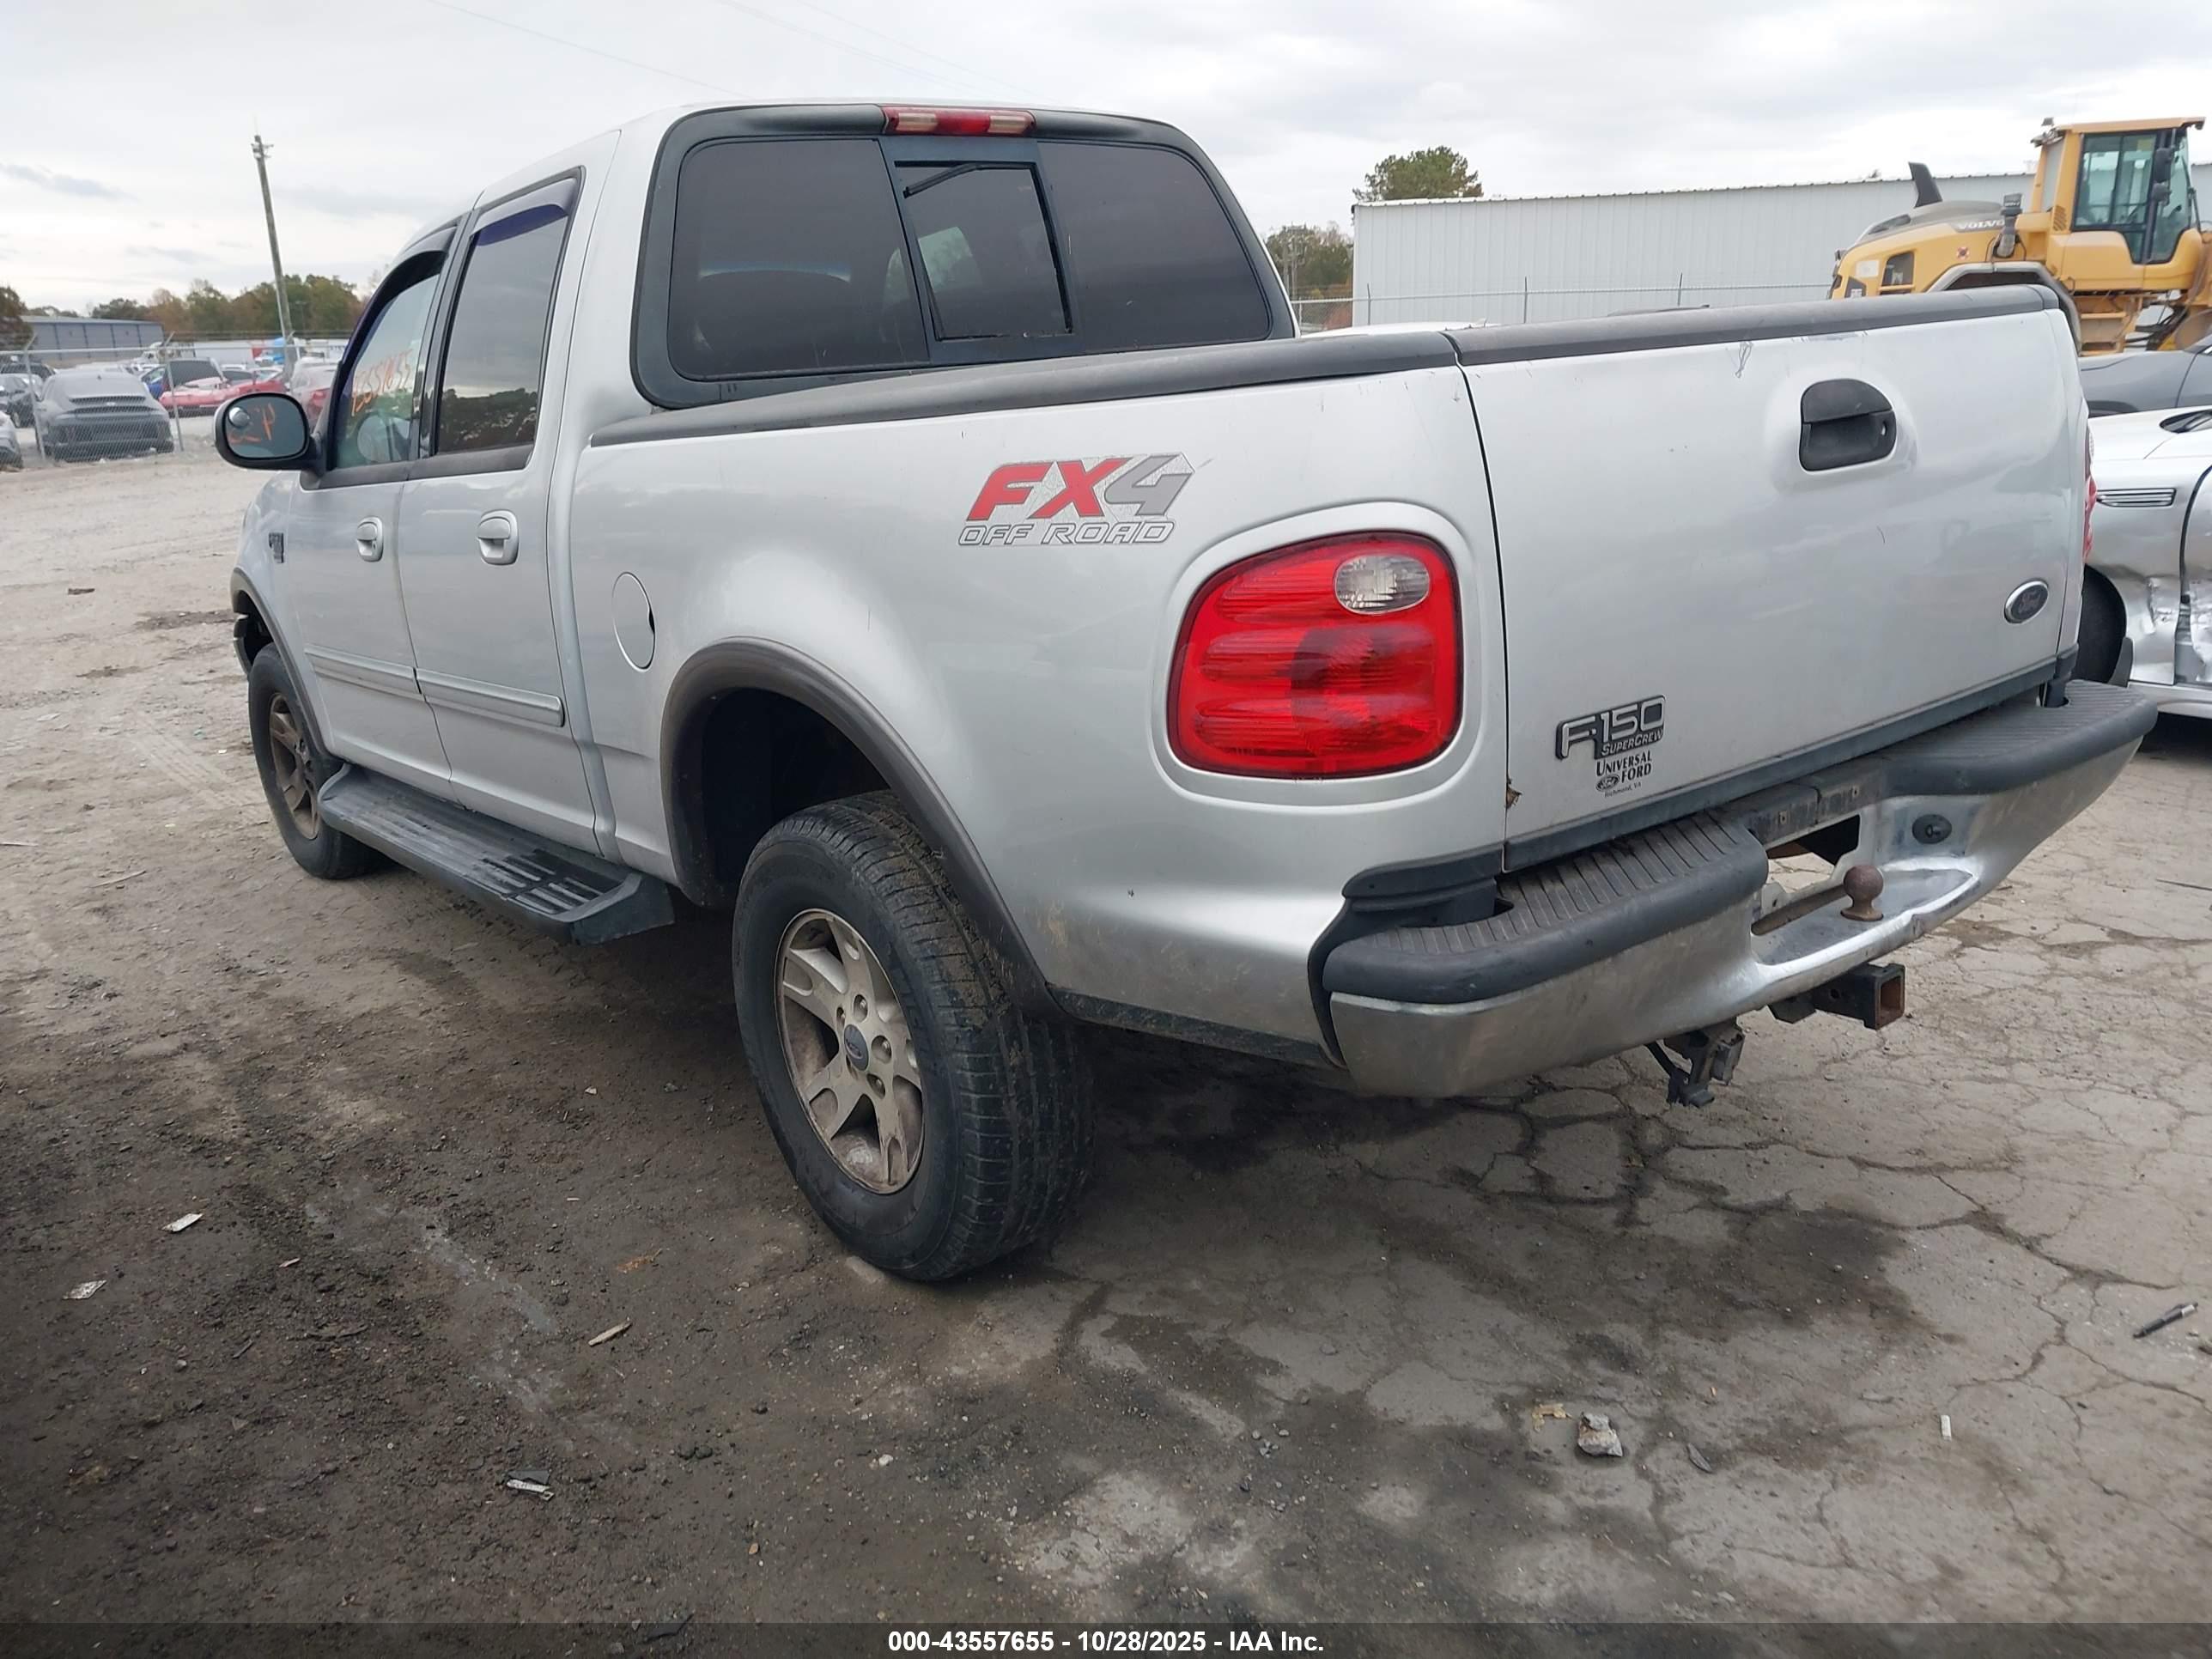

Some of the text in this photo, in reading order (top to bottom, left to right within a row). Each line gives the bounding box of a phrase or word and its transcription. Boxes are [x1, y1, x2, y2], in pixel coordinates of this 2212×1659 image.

[966, 454, 1193, 521] FX4
[958, 520, 1175, 545] OFF ROAD
[1621, 763, 1652, 783] FORD
